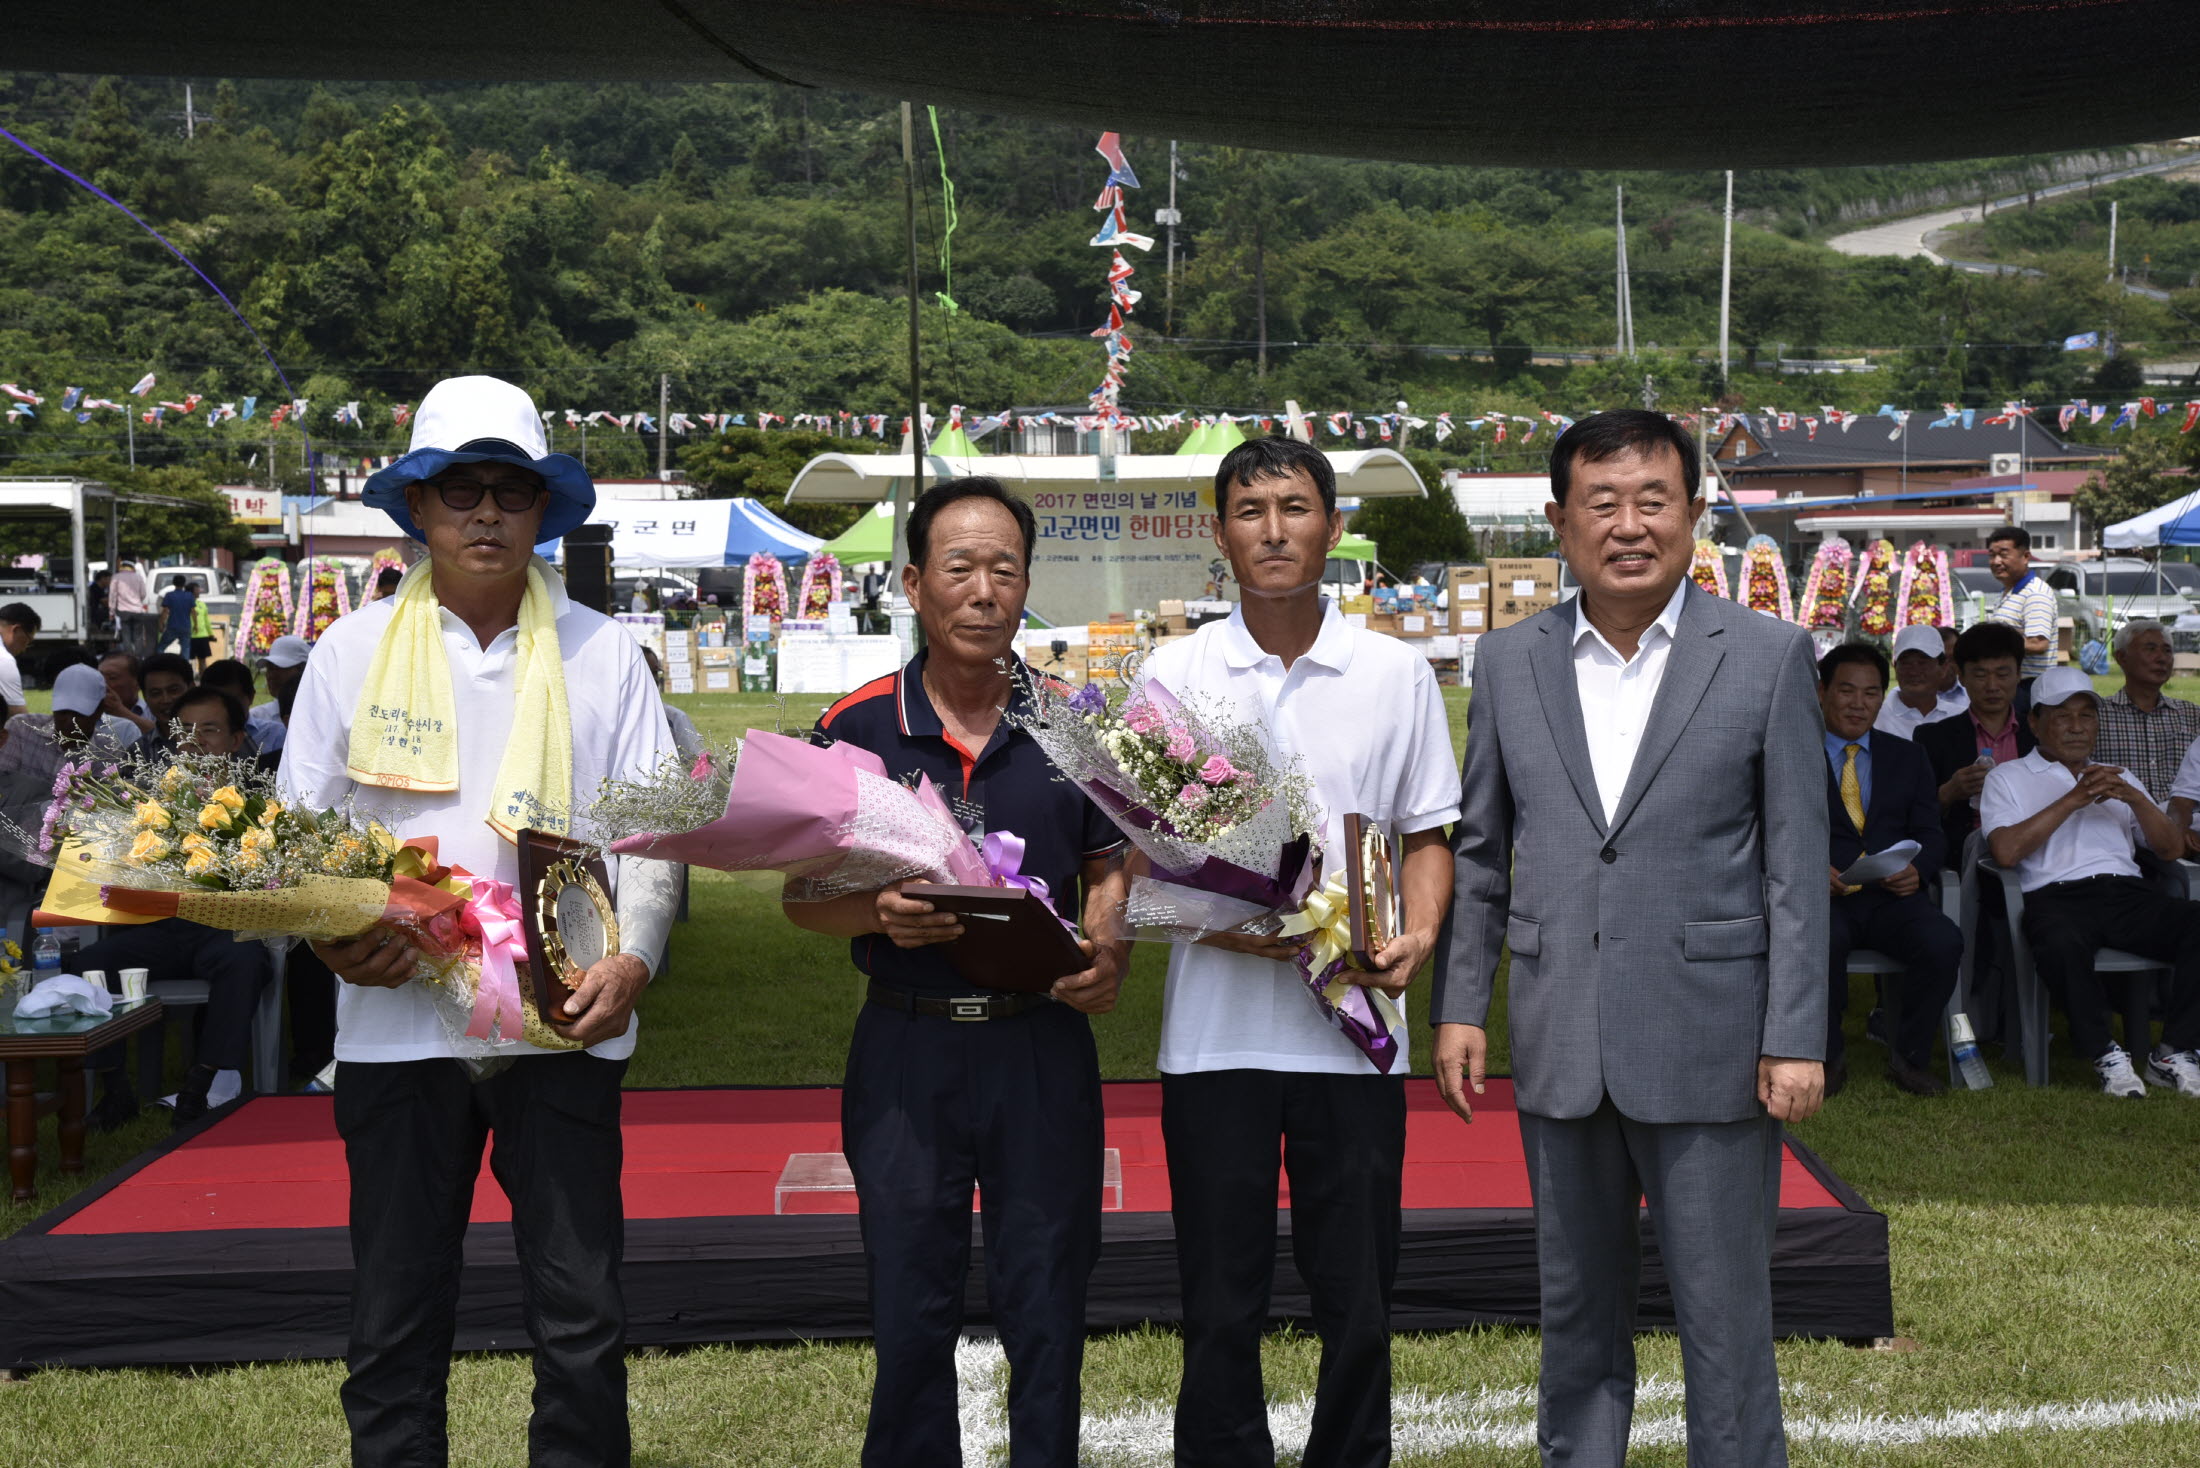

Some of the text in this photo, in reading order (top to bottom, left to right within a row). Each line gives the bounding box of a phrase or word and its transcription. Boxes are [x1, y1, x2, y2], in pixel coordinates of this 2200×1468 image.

[1034, 491, 1197, 509] 2017 면민의 날 기념
[1038, 515, 1120, 540] 고군면민
